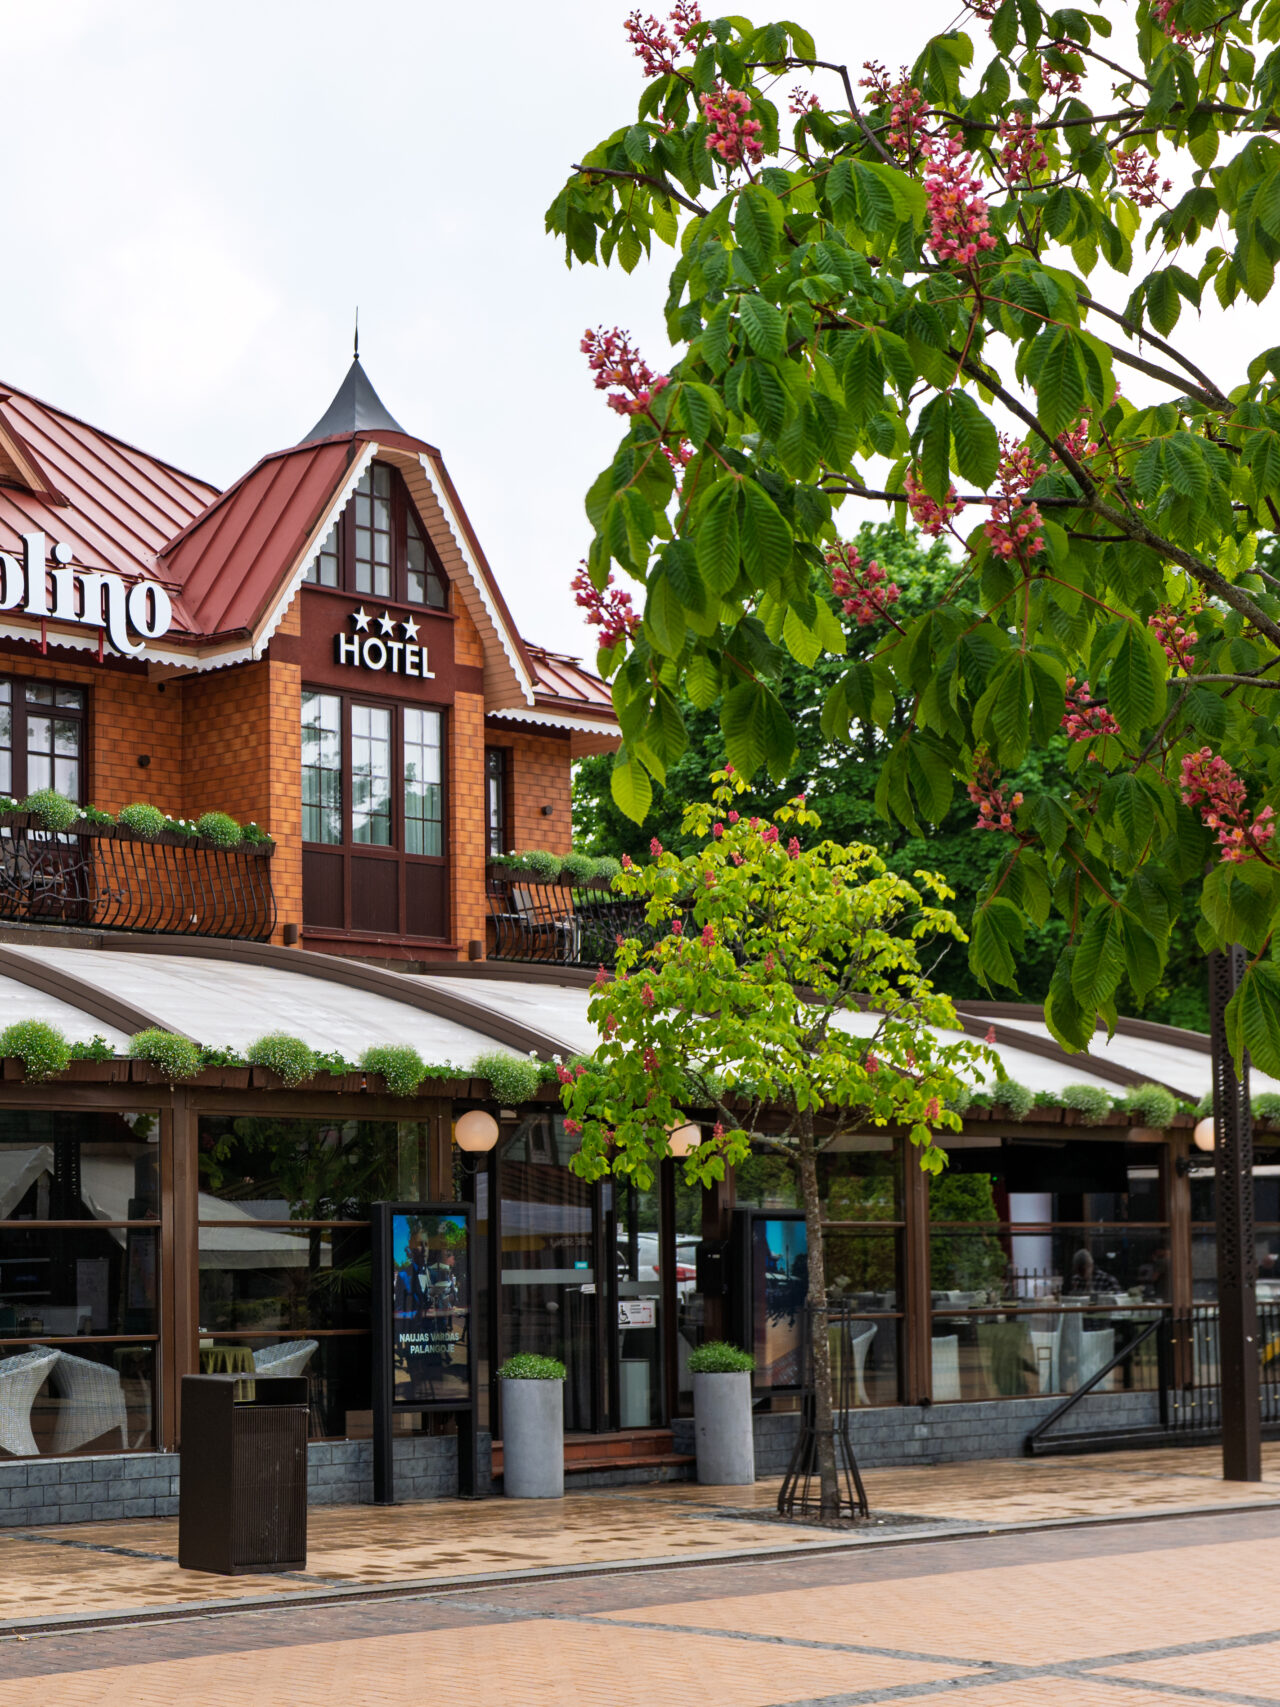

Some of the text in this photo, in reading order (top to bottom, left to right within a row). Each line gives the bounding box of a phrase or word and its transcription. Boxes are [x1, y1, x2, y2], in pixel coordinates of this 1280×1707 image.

[339, 632, 436, 679] HOTEL
[399, 1332, 460, 1342] NAUJAS VARDAS
[410, 1343, 455, 1354] PALANGOJE
